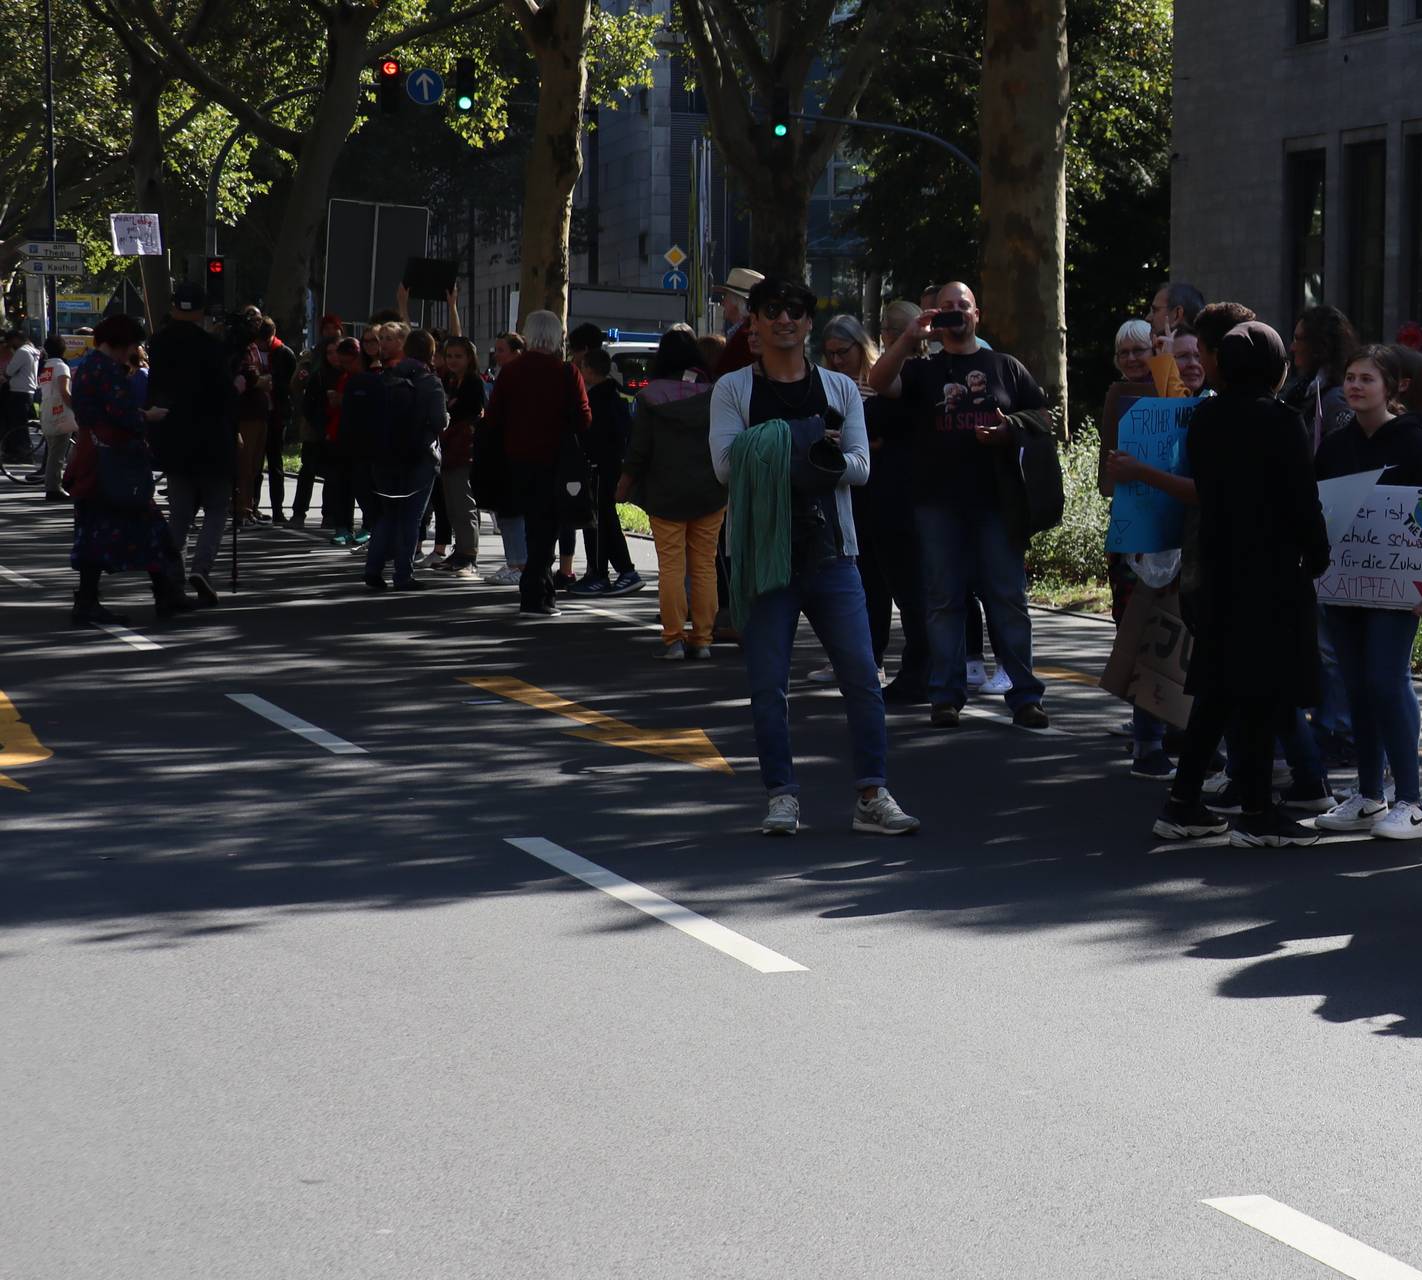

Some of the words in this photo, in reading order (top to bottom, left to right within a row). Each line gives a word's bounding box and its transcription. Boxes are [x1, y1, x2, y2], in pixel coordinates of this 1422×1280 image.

[48, 264, 78, 272] Kaufhof
[1355, 506, 1377, 519] er
[1384, 496, 1405, 521] ist
[1339, 525, 1381, 545] chule
[1402, 512, 1419, 537] THE
[1340, 549, 1361, 568] für
[1361, 552, 1387, 570] die
[1315, 572, 1407, 600] KÄMPFEN
